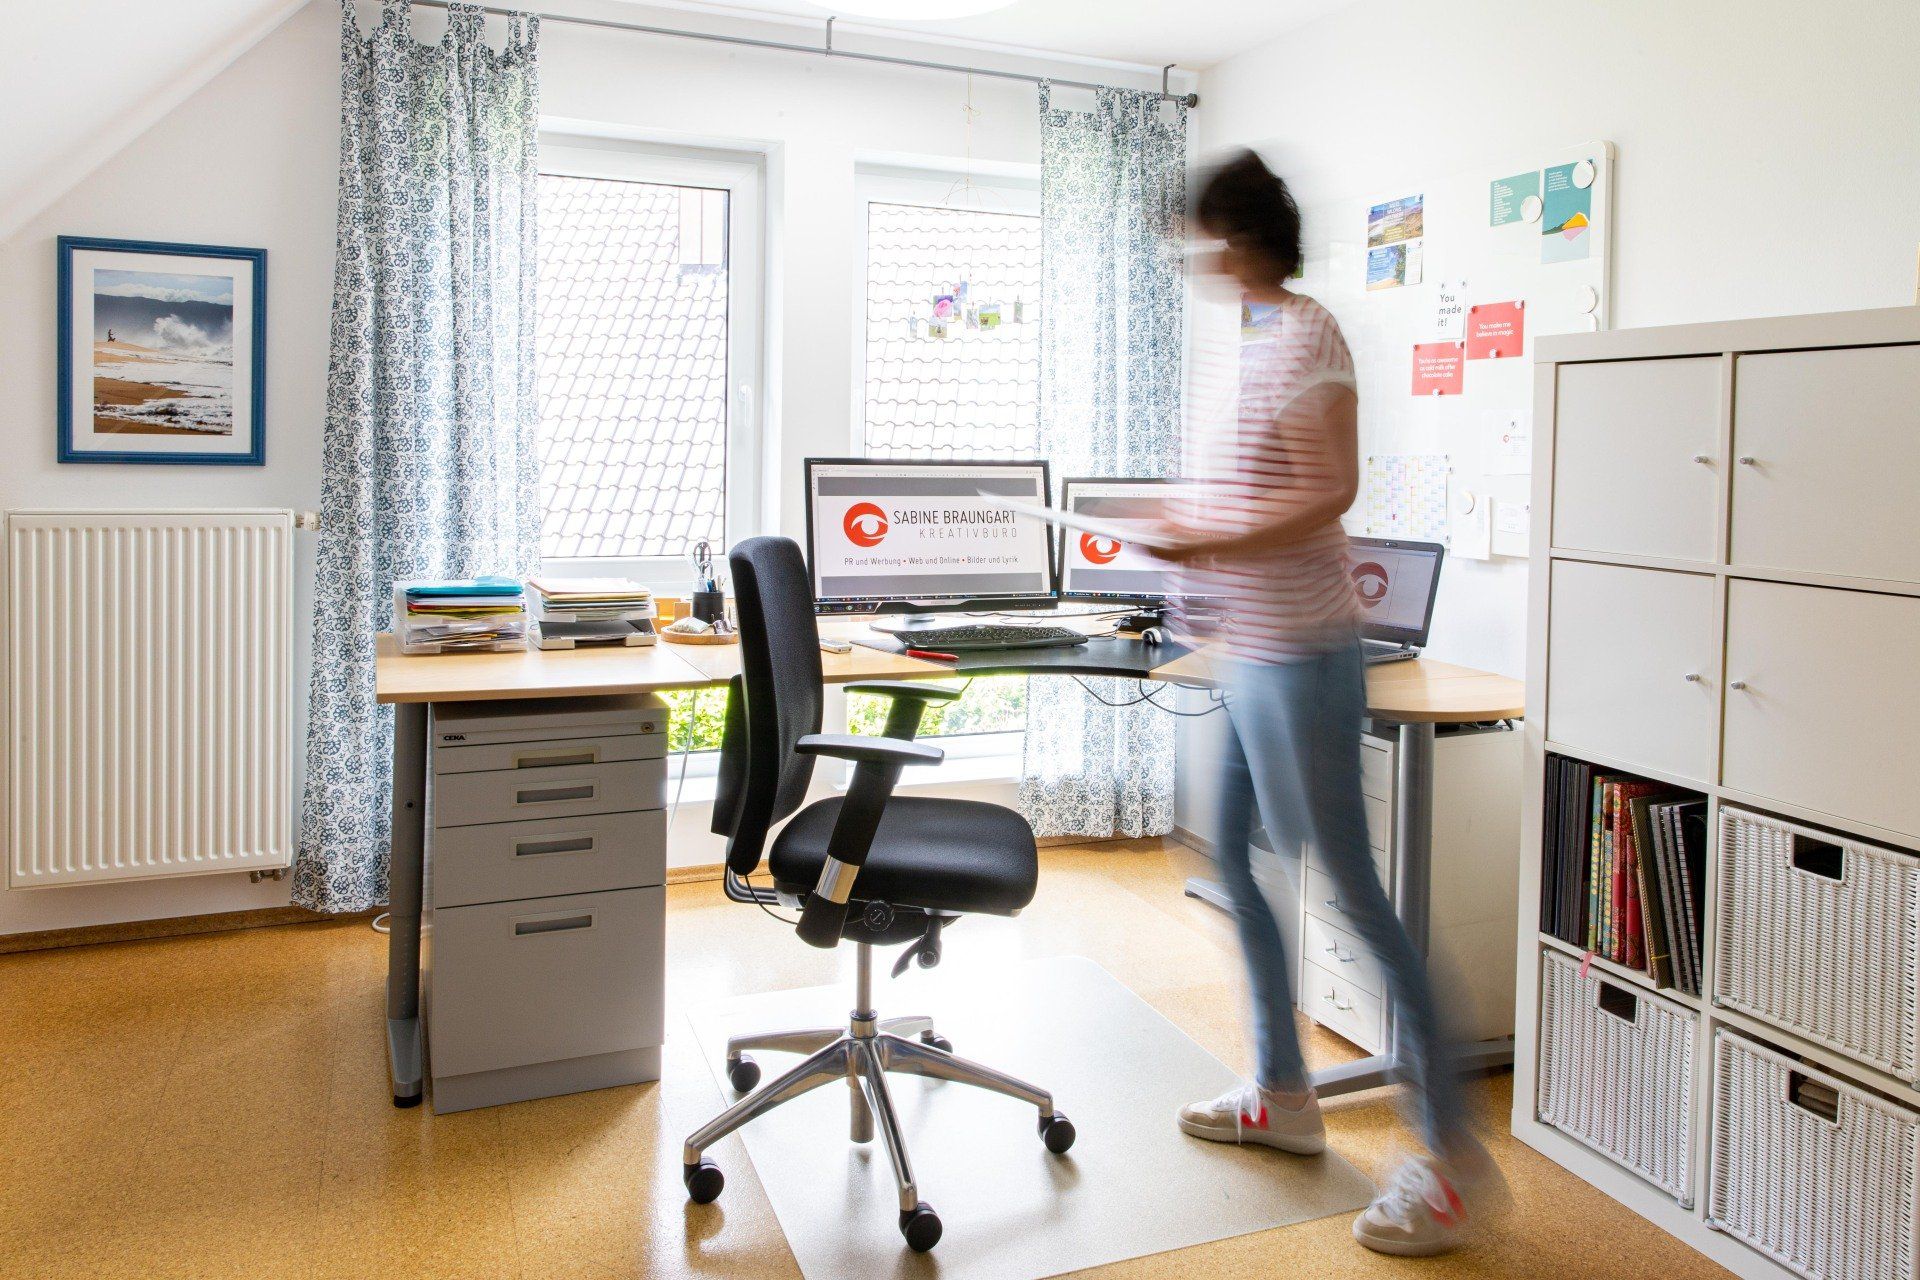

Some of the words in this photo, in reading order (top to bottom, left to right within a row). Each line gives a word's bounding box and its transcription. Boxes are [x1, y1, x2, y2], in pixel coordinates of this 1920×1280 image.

[1440, 294, 1455, 302] You
[1439, 305, 1462, 315] made
[1438, 318, 1447, 327] it!
[893, 510, 939, 525] SABINE
[943, 510, 1017, 524] BRAUNGART
[844, 557, 854, 565] PR
[856, 557, 868, 565] und
[870, 557, 901, 567] Werbung
[939, 556, 960, 564] Online
[967, 556, 986, 564] Bilder
[1002, 556, 1019, 565] Lyrik
